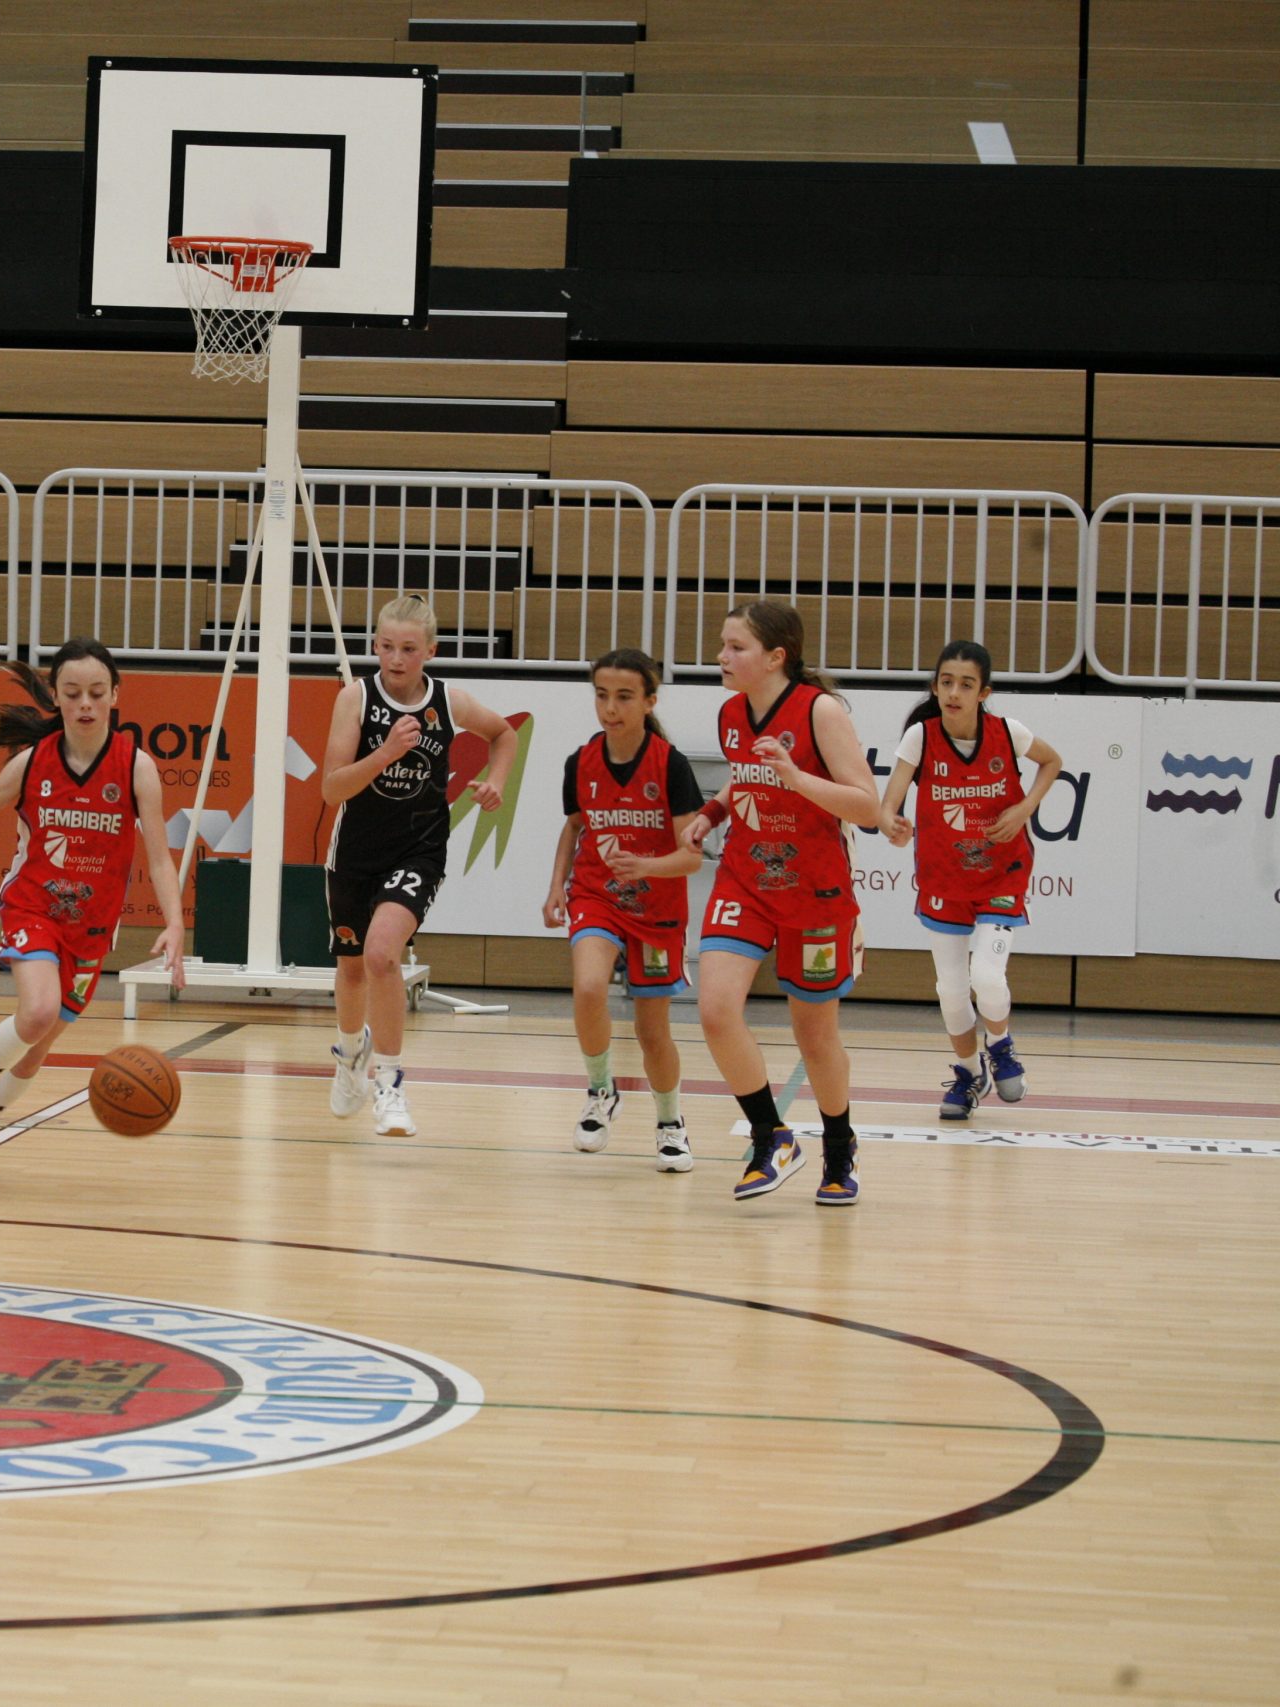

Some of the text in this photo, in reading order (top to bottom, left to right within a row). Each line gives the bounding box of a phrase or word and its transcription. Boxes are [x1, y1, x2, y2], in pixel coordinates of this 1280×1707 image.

[370, 704, 392, 726] 32
[724, 728, 740, 750] 12
[933, 760, 949, 778] 10
[40, 779, 52, 797] 8
[589, 781, 598, 800] 7
[931, 777, 1008, 801] BEMBIBRE
[37, 805, 123, 836] BEMBIBRE
[585, 809, 665, 830] BEMBIBRE
[383, 869, 423, 897] 32
[711, 899, 742, 927] 12
